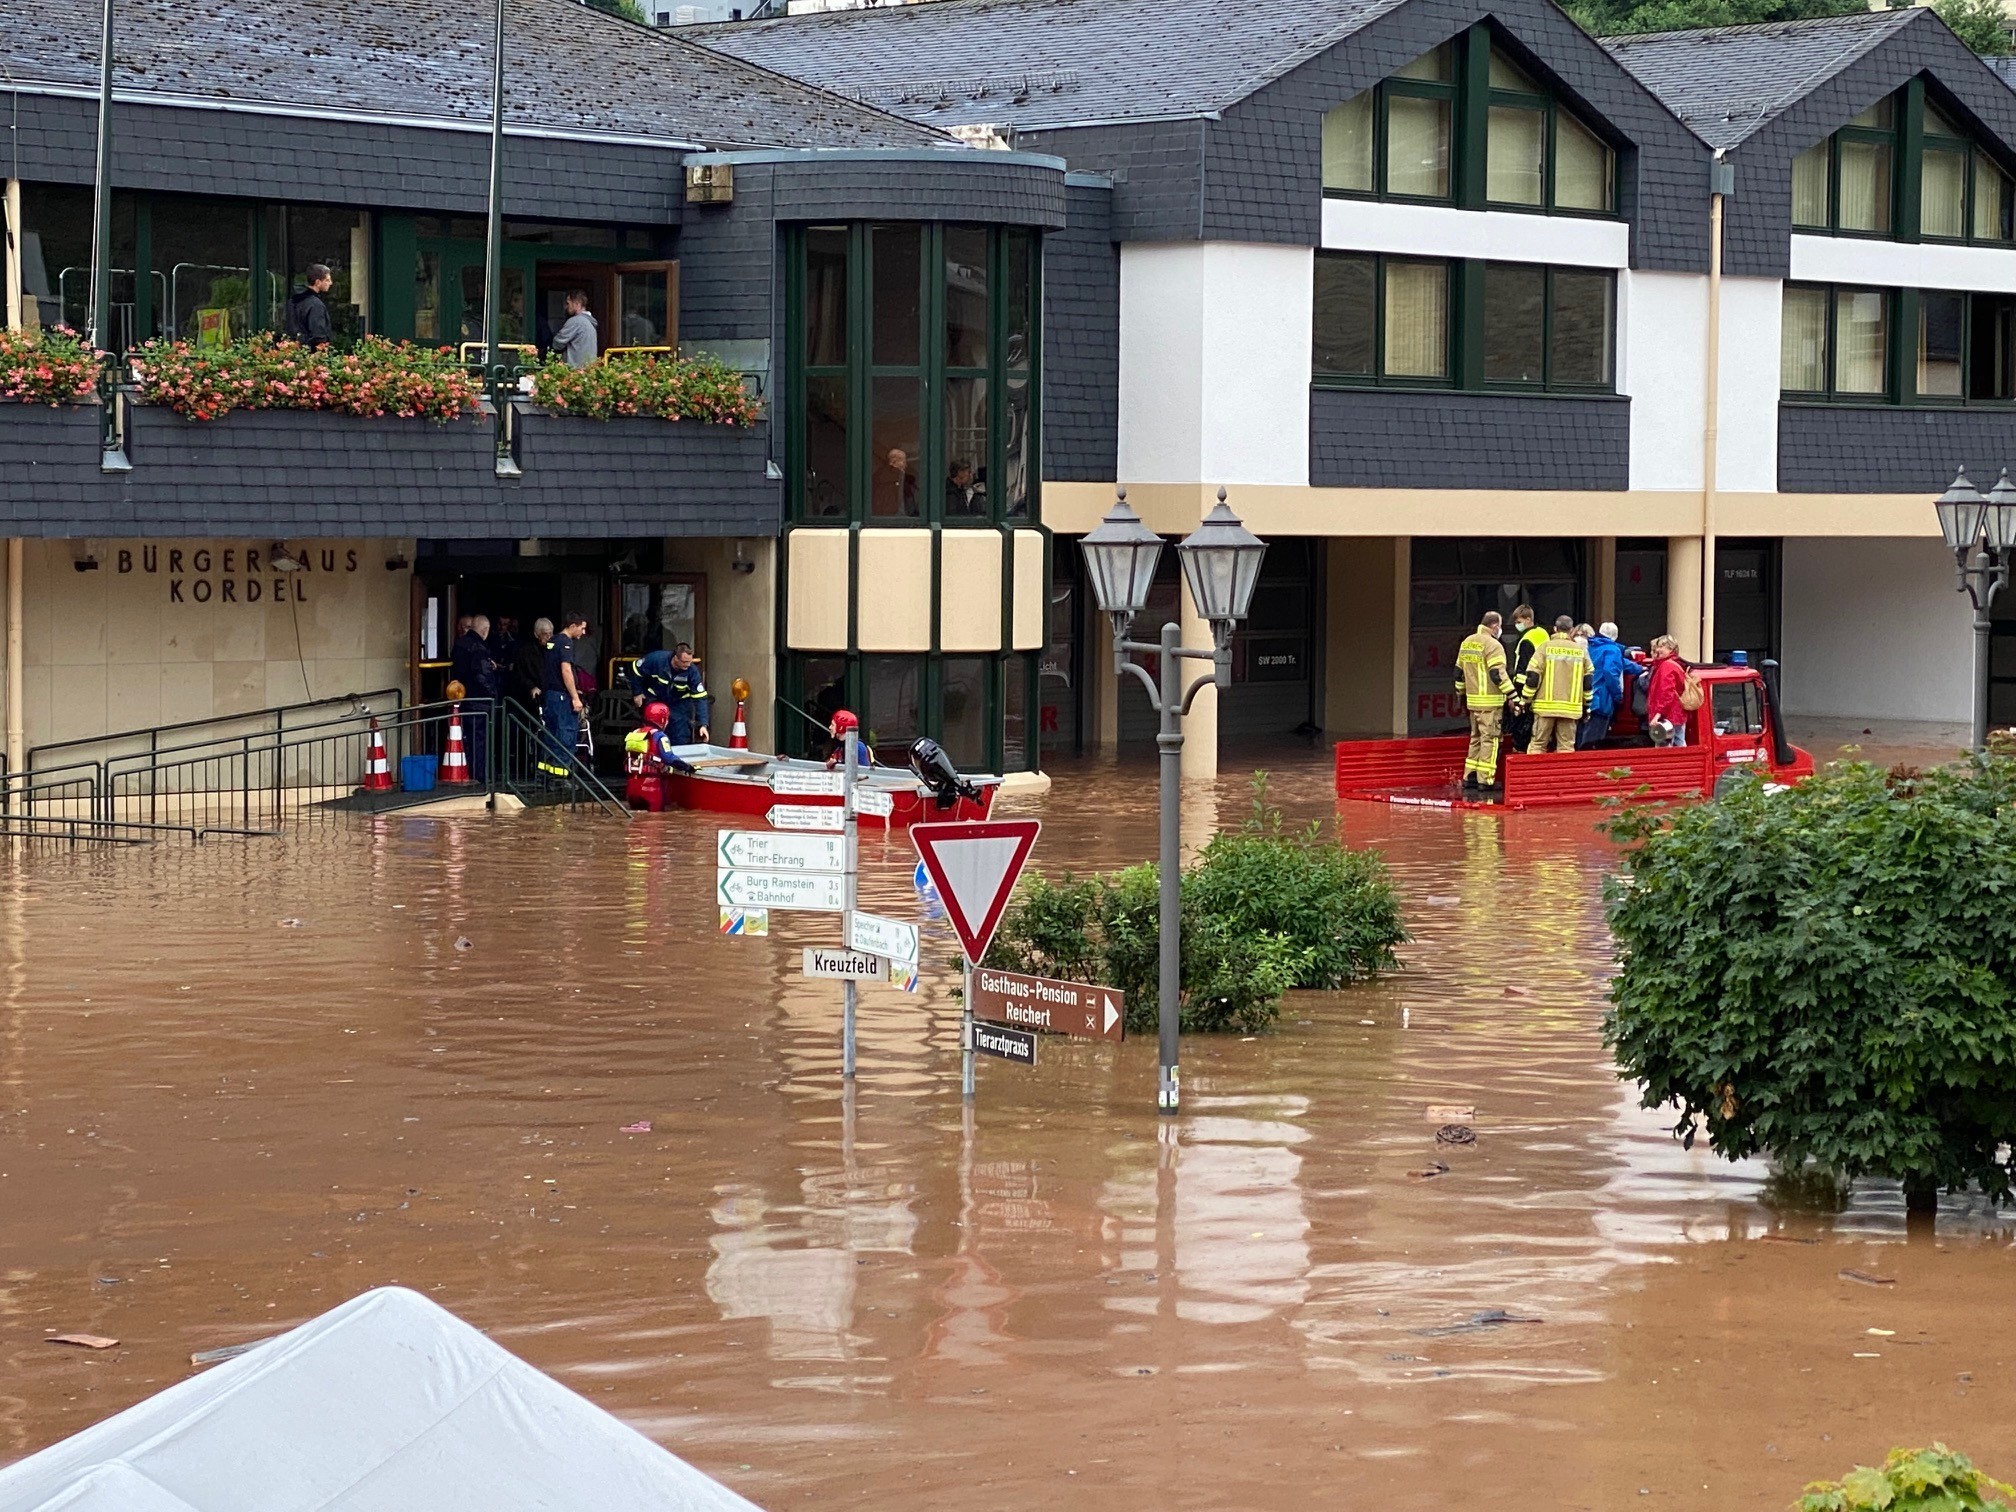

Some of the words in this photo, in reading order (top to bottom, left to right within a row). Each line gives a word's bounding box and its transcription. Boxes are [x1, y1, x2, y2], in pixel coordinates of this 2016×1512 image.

[118, 545, 357, 573] BÜRGERAUS
[170, 579, 307, 602] KORDEL
[1258, 656, 1270, 665] SW
[1427, 645, 1438, 667] 3
[1547, 647, 1583, 656] FEUERWEHR
[747, 837, 768, 849] Trier
[826, 841, 834, 852] 18
[747, 852, 805, 868] Trier-Ehrang
[746, 875, 768, 889] Burg
[771, 877, 815, 890] Ramstein
[757, 891, 795, 903] Bahnhof
[815, 953, 877, 975] Kreuzfeld
[981, 972, 1078, 1006] Gasthaus-Pension
[1006, 1001, 1051, 1027] Reichert
[975, 1027, 1029, 1058] Tierarztpraxis
